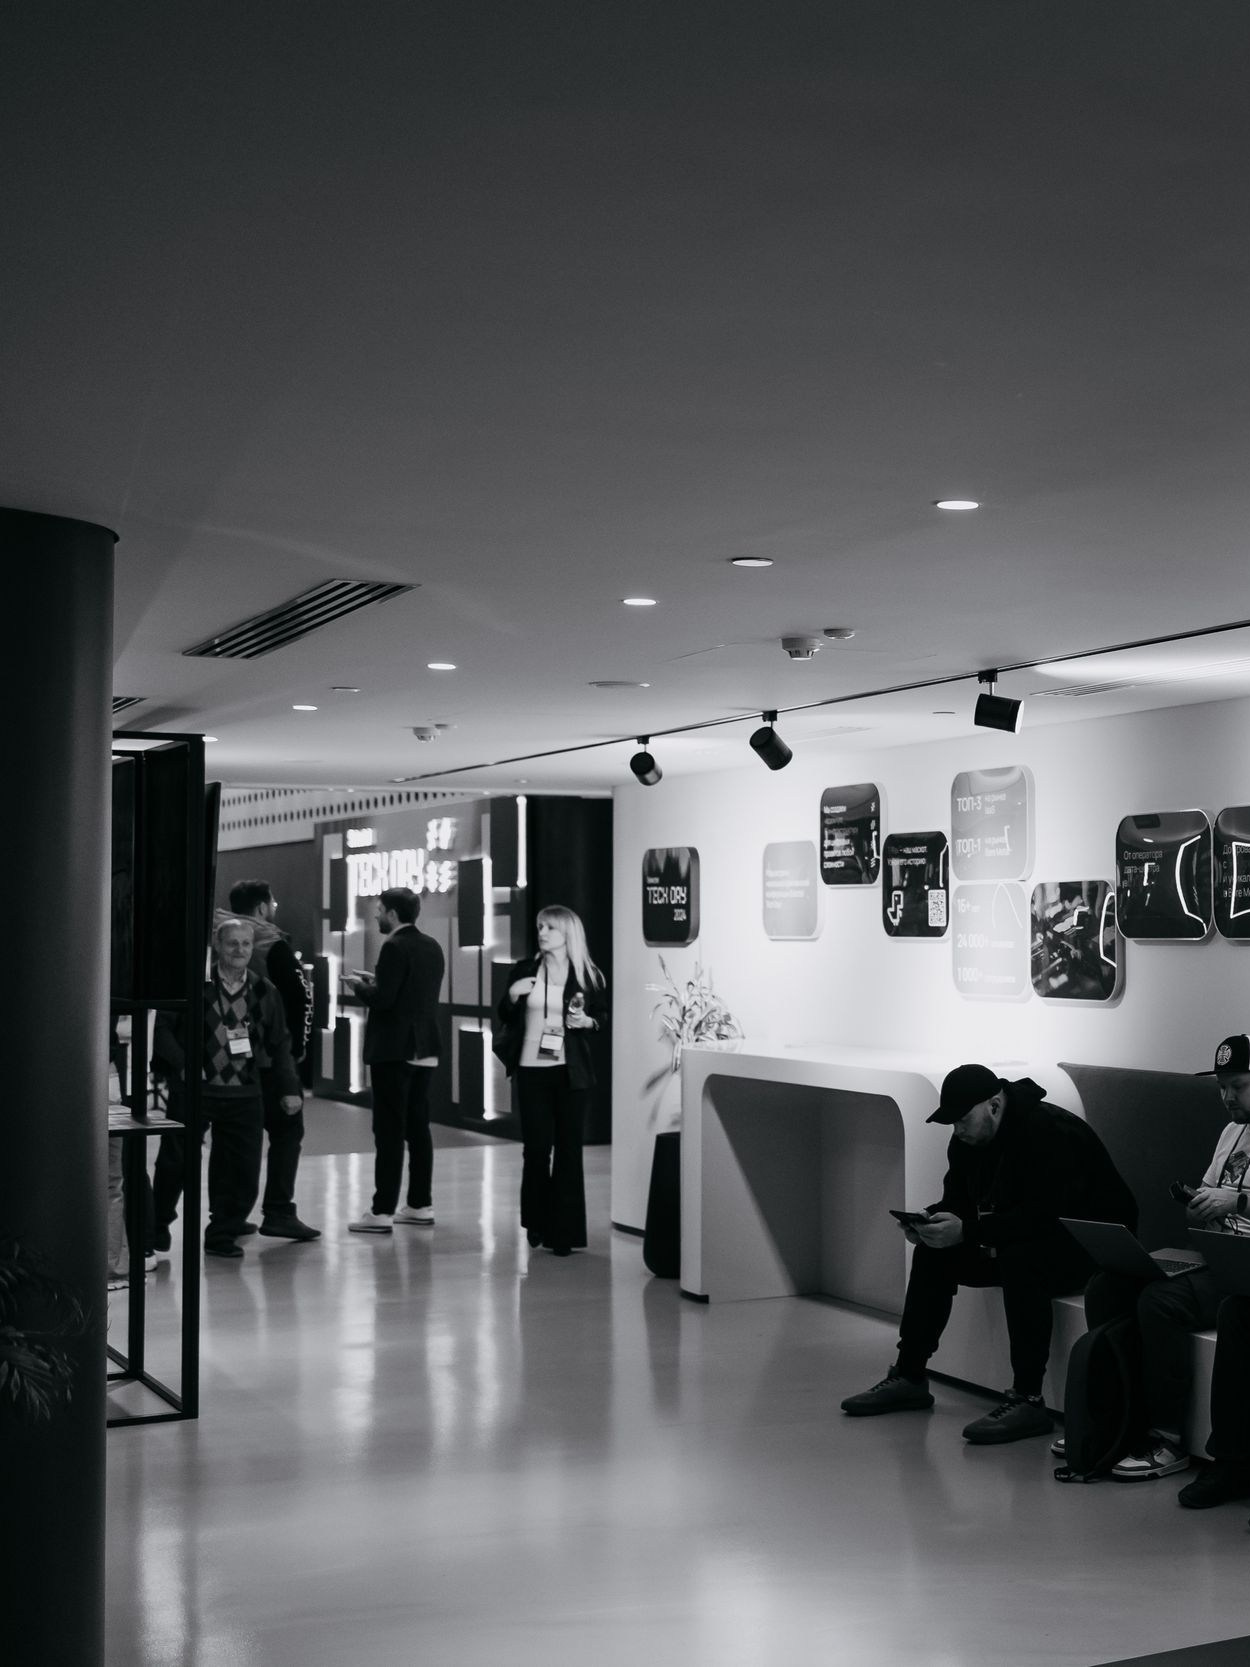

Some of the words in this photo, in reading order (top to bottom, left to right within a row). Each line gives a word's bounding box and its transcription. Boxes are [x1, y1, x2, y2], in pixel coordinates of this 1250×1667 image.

[956, 796, 982, 812] ТОП-3
[956, 838, 981, 852] ТОП-1
[646, 886, 669, 904] TECH
[670, 886, 687, 904] DAY
